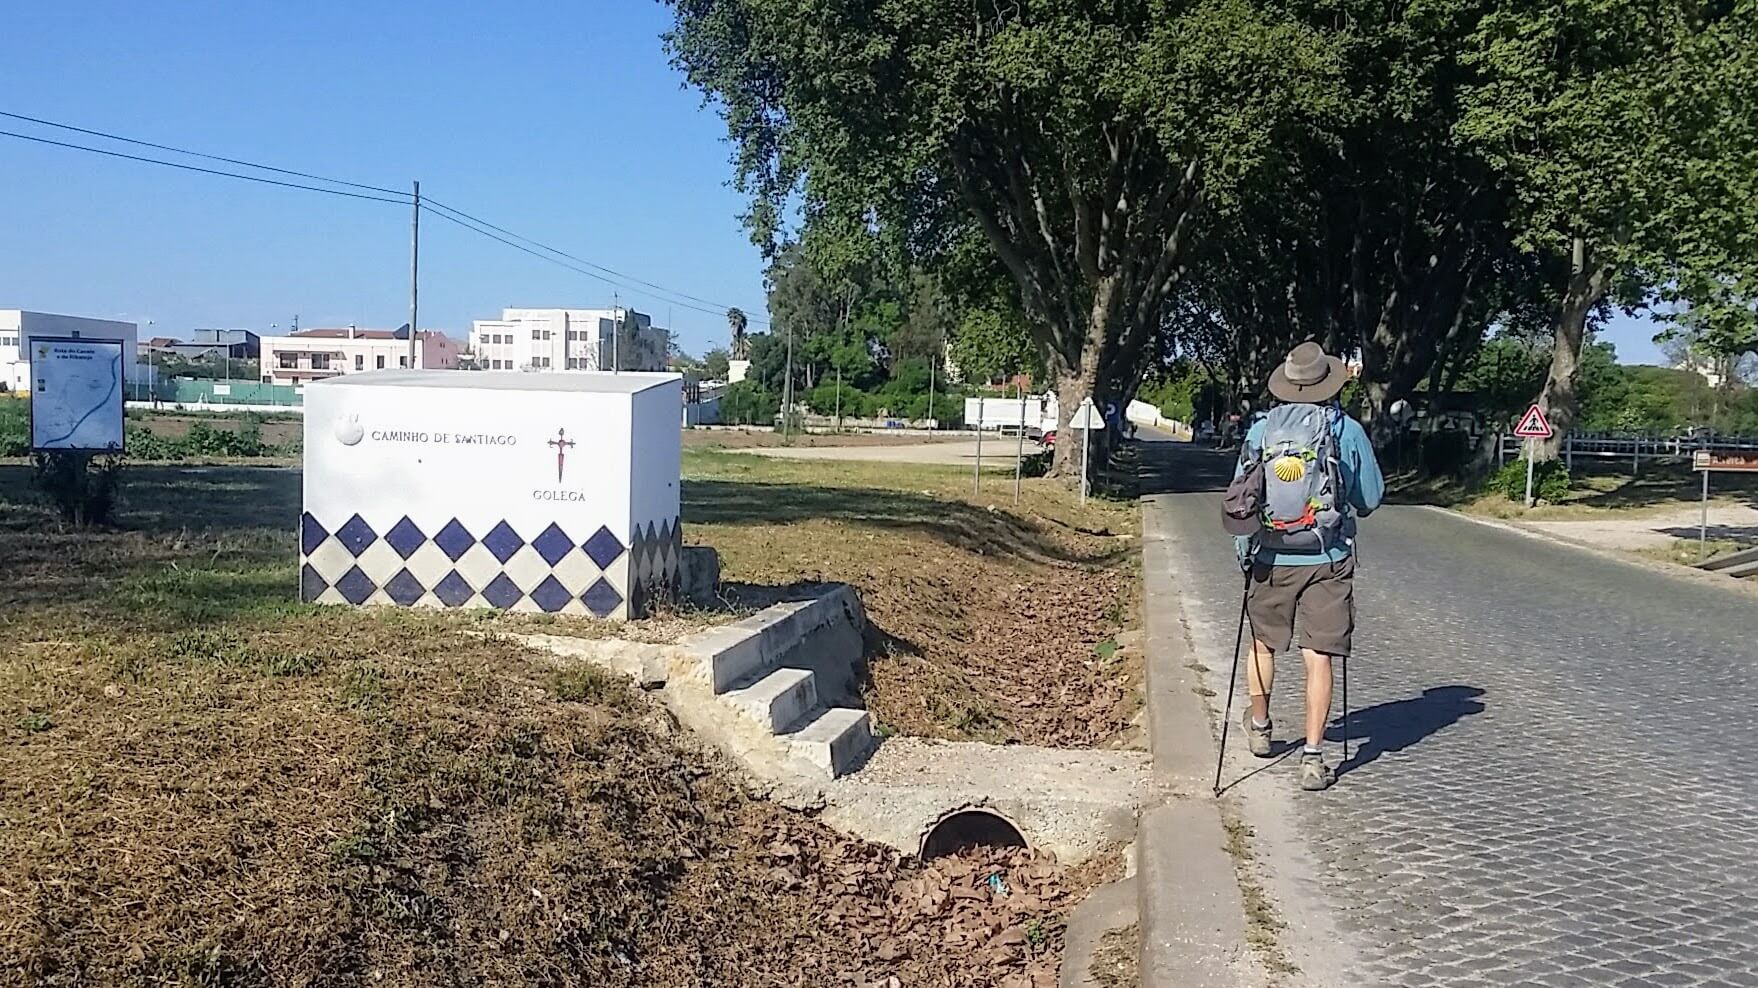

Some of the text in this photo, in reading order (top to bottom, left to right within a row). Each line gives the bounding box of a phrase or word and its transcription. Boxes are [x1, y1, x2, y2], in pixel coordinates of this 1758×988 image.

[371, 430, 517, 446] CAMINHO DE SANTIAGO
